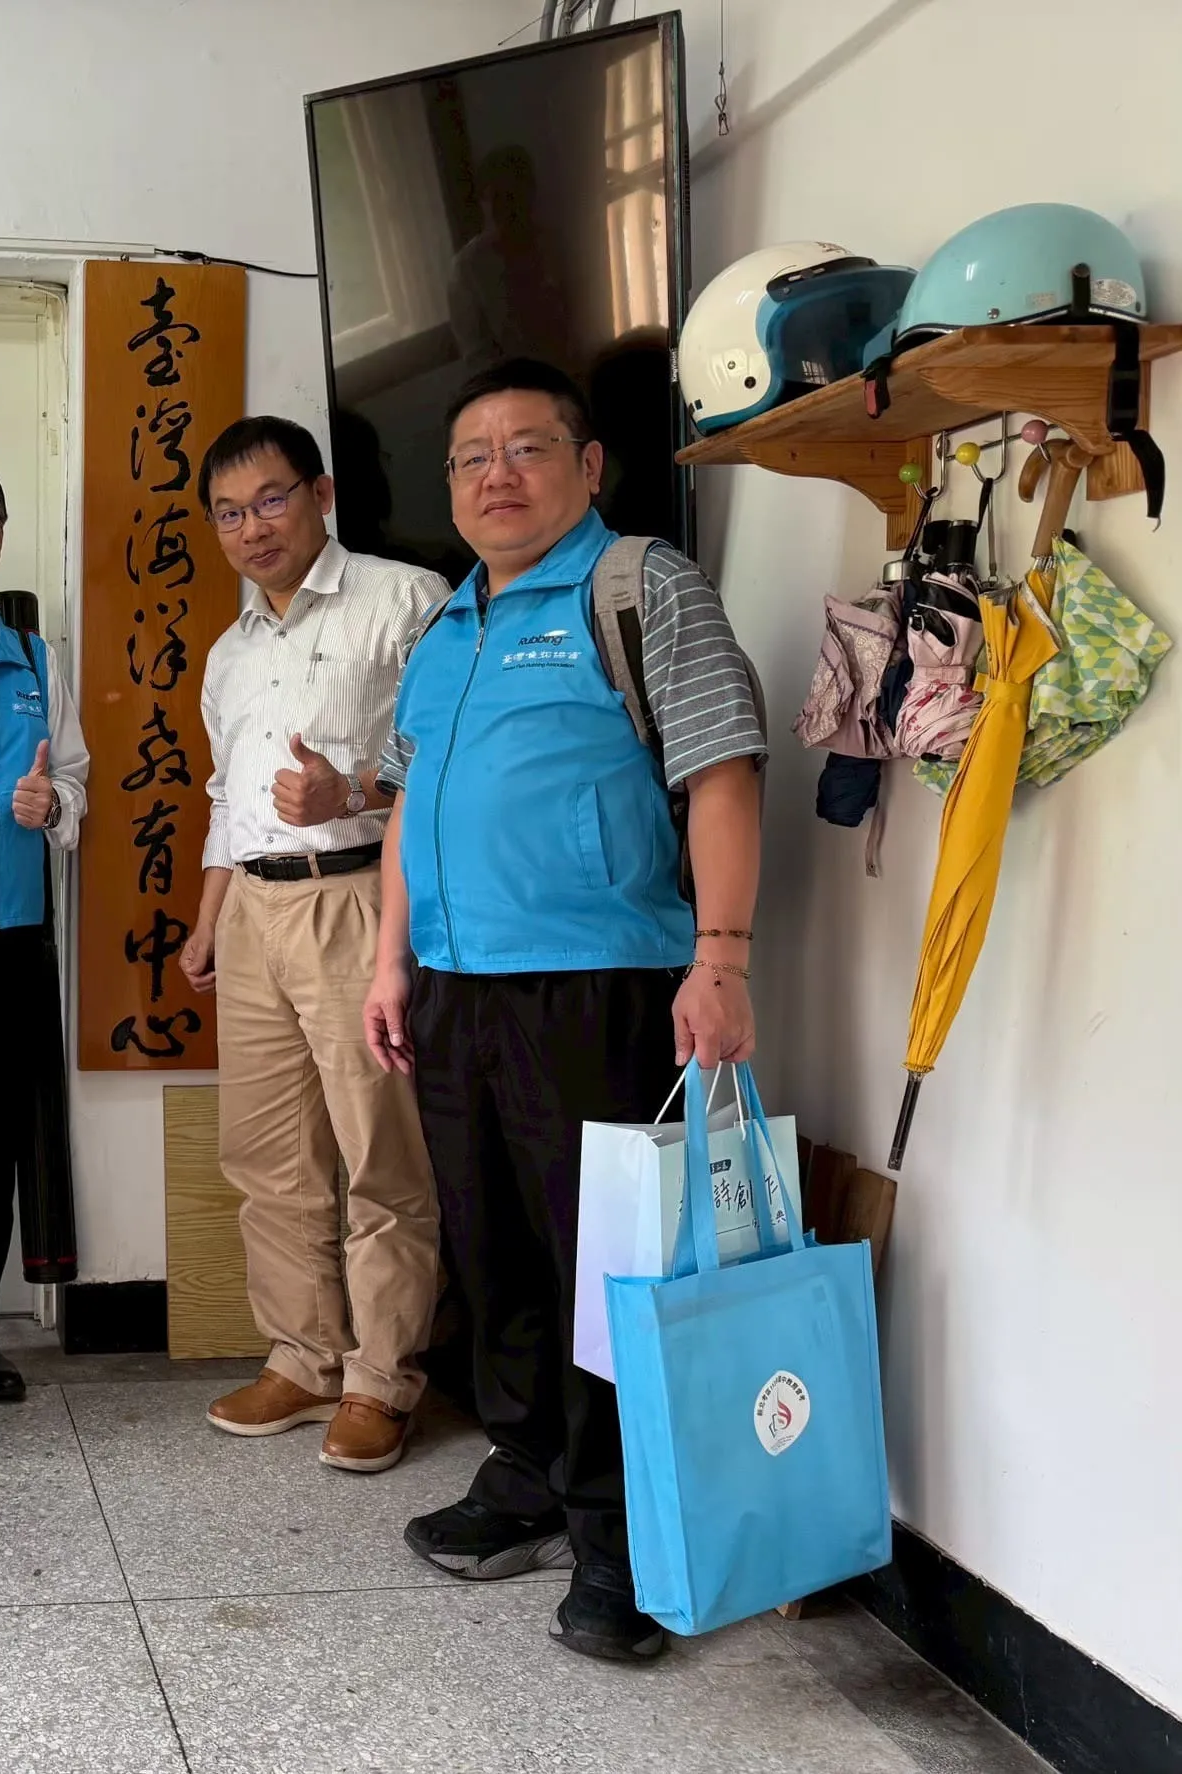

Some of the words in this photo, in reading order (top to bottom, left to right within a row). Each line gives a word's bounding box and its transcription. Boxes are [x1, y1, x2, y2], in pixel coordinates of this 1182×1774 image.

[110, 276, 202, 1058] 臺灣海洋教育中心
